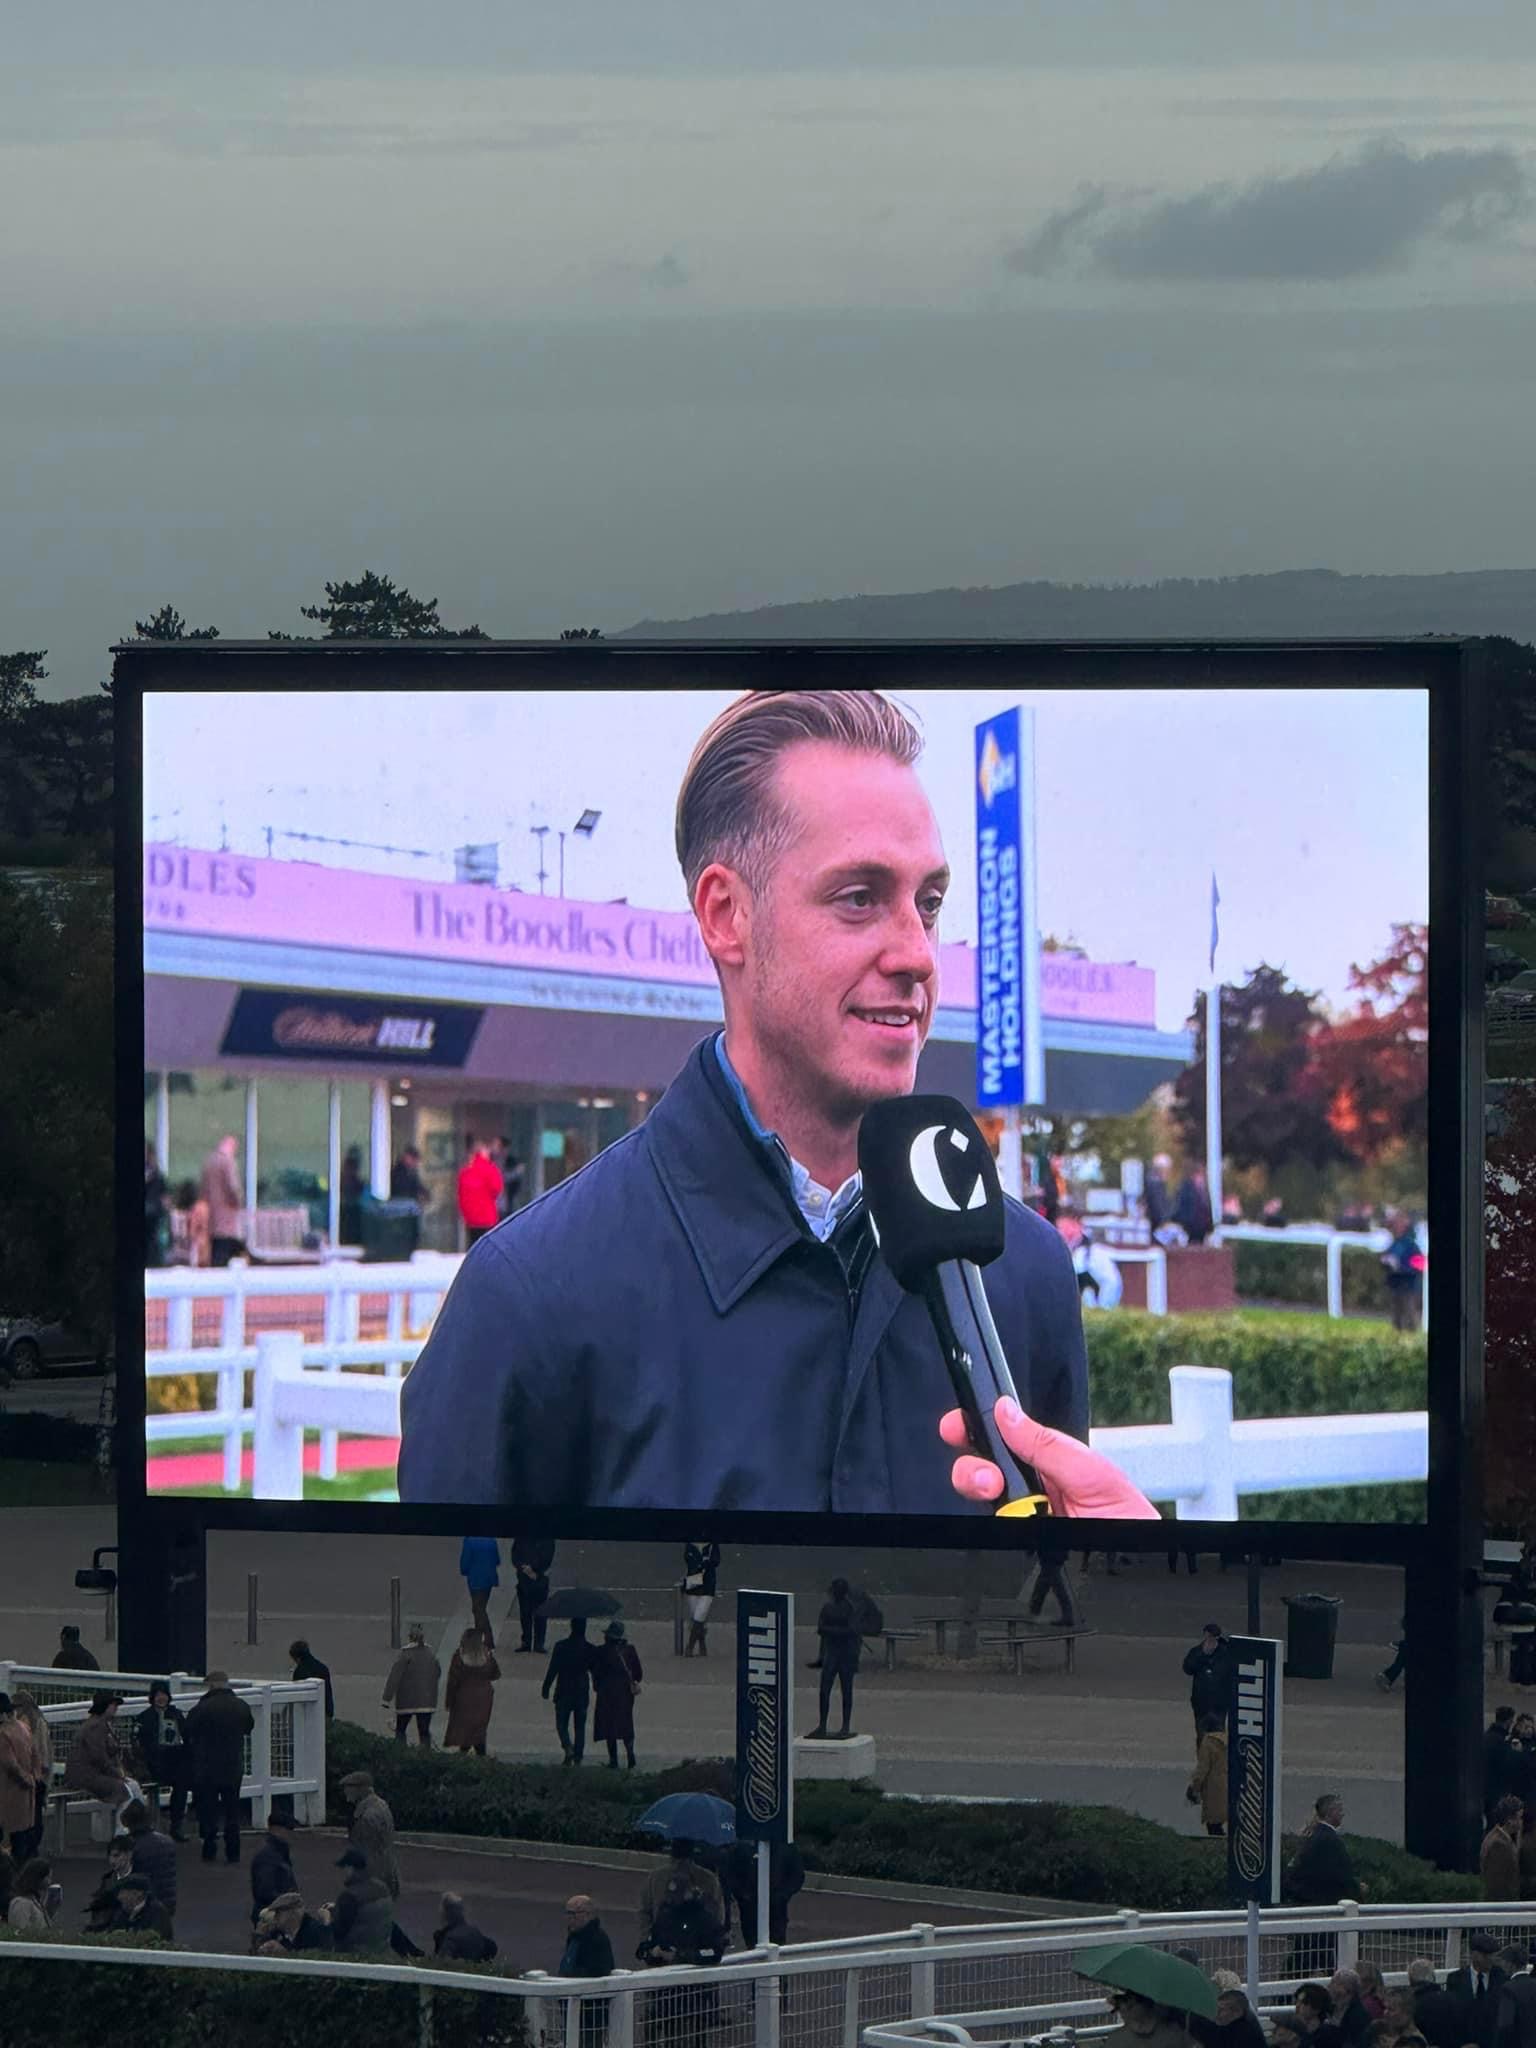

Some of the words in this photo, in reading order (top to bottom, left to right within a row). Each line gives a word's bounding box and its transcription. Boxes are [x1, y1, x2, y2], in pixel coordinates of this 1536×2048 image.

[412, 892, 475, 941] The
[485, 900, 617, 957] Boodles
[999, 844, 1021, 1068] HOLDINGS
[748, 1611, 777, 1686] HILL
[1238, 1658, 1265, 1737] HILL
